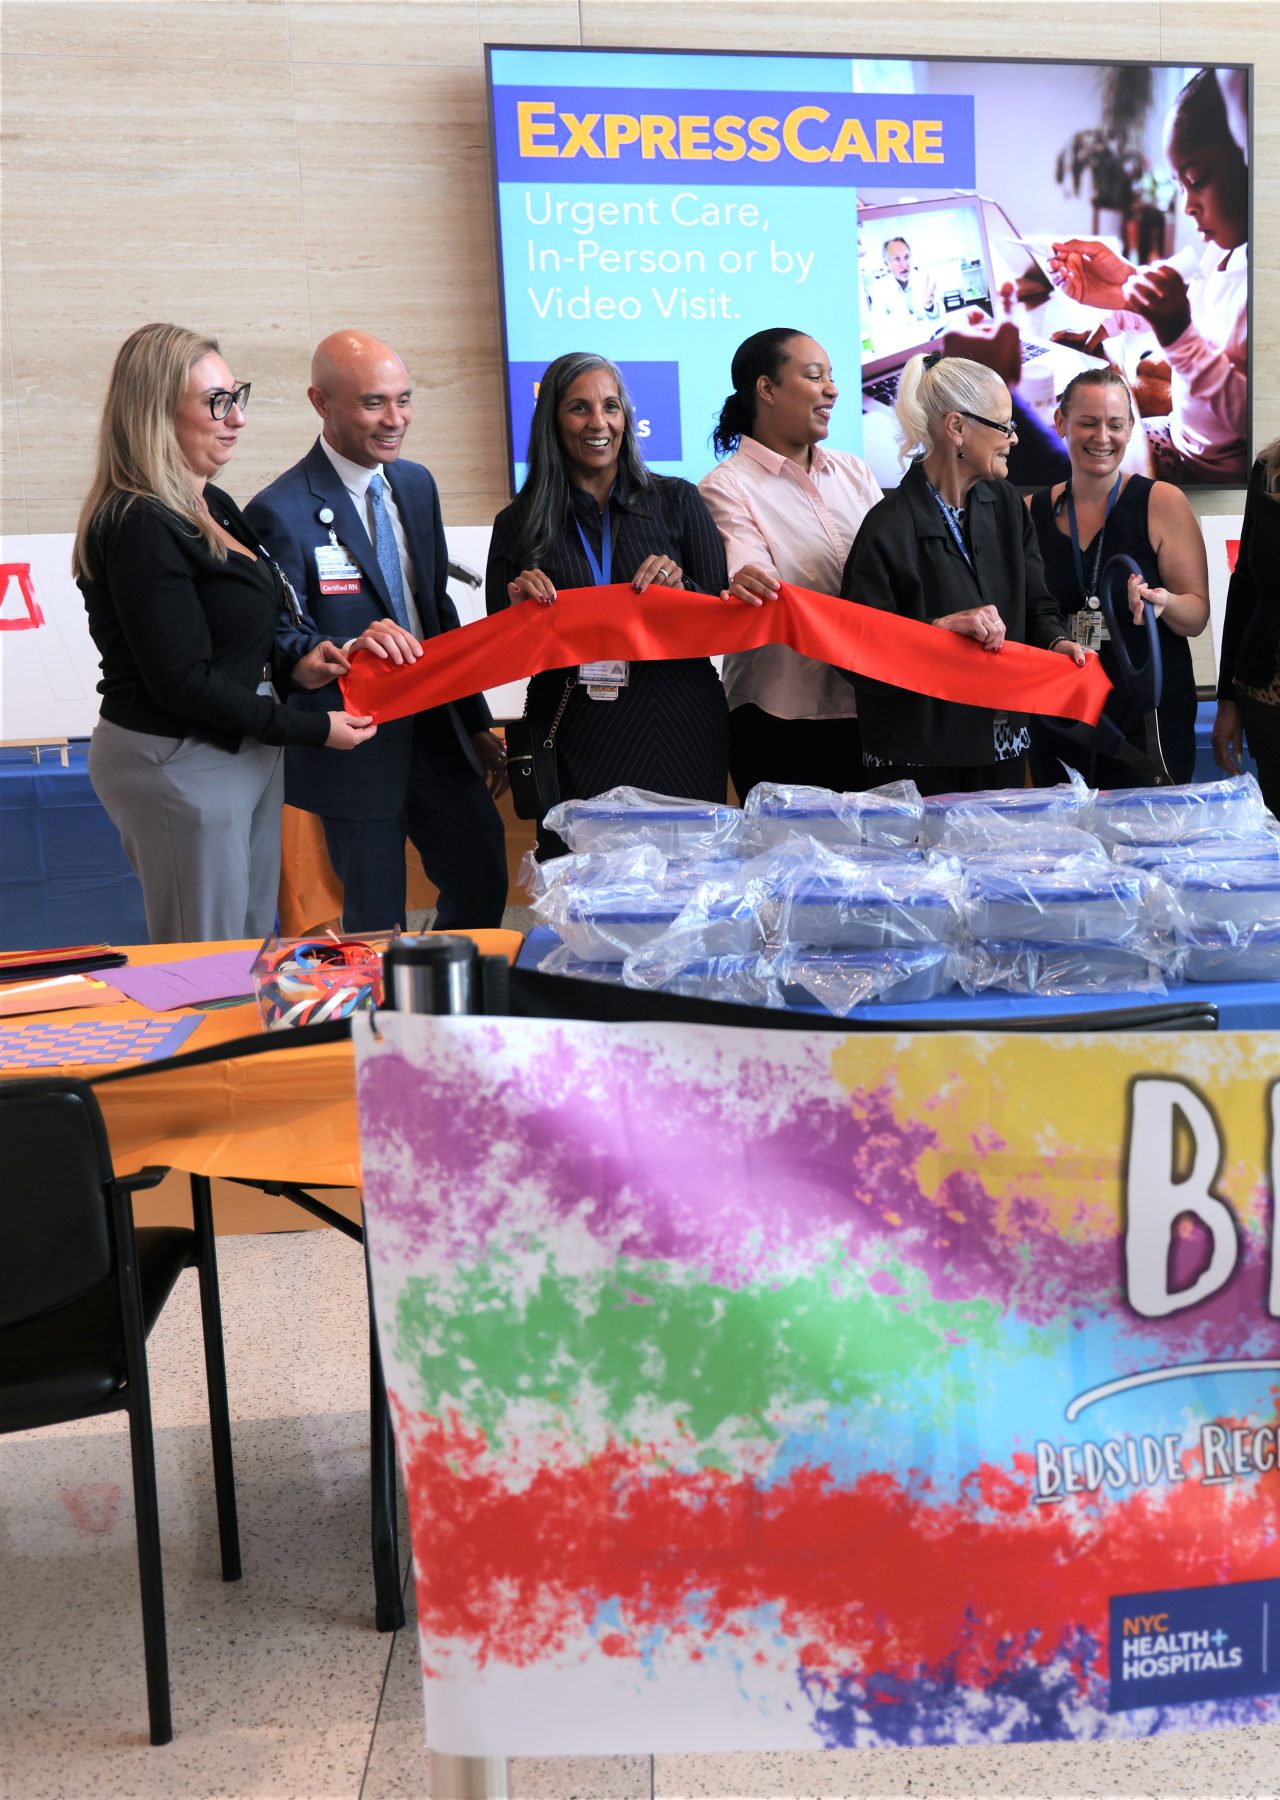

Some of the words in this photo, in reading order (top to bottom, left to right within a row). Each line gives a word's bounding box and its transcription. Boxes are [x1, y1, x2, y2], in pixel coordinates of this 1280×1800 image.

[525, 191, 658, 235] Urgent
[671, 192, 770, 231] Care,
[527, 239, 706, 274] In-Person
[718, 247, 759, 273] or
[770, 240, 816, 283] by
[527, 286, 642, 320] Video
[651, 287, 742, 320] Visit.
[1035, 1432, 1186, 1501] BEDSIDE
[1122, 1613, 1169, 1636] NYC
[1122, 1647, 1243, 1681] HOSPITALS
